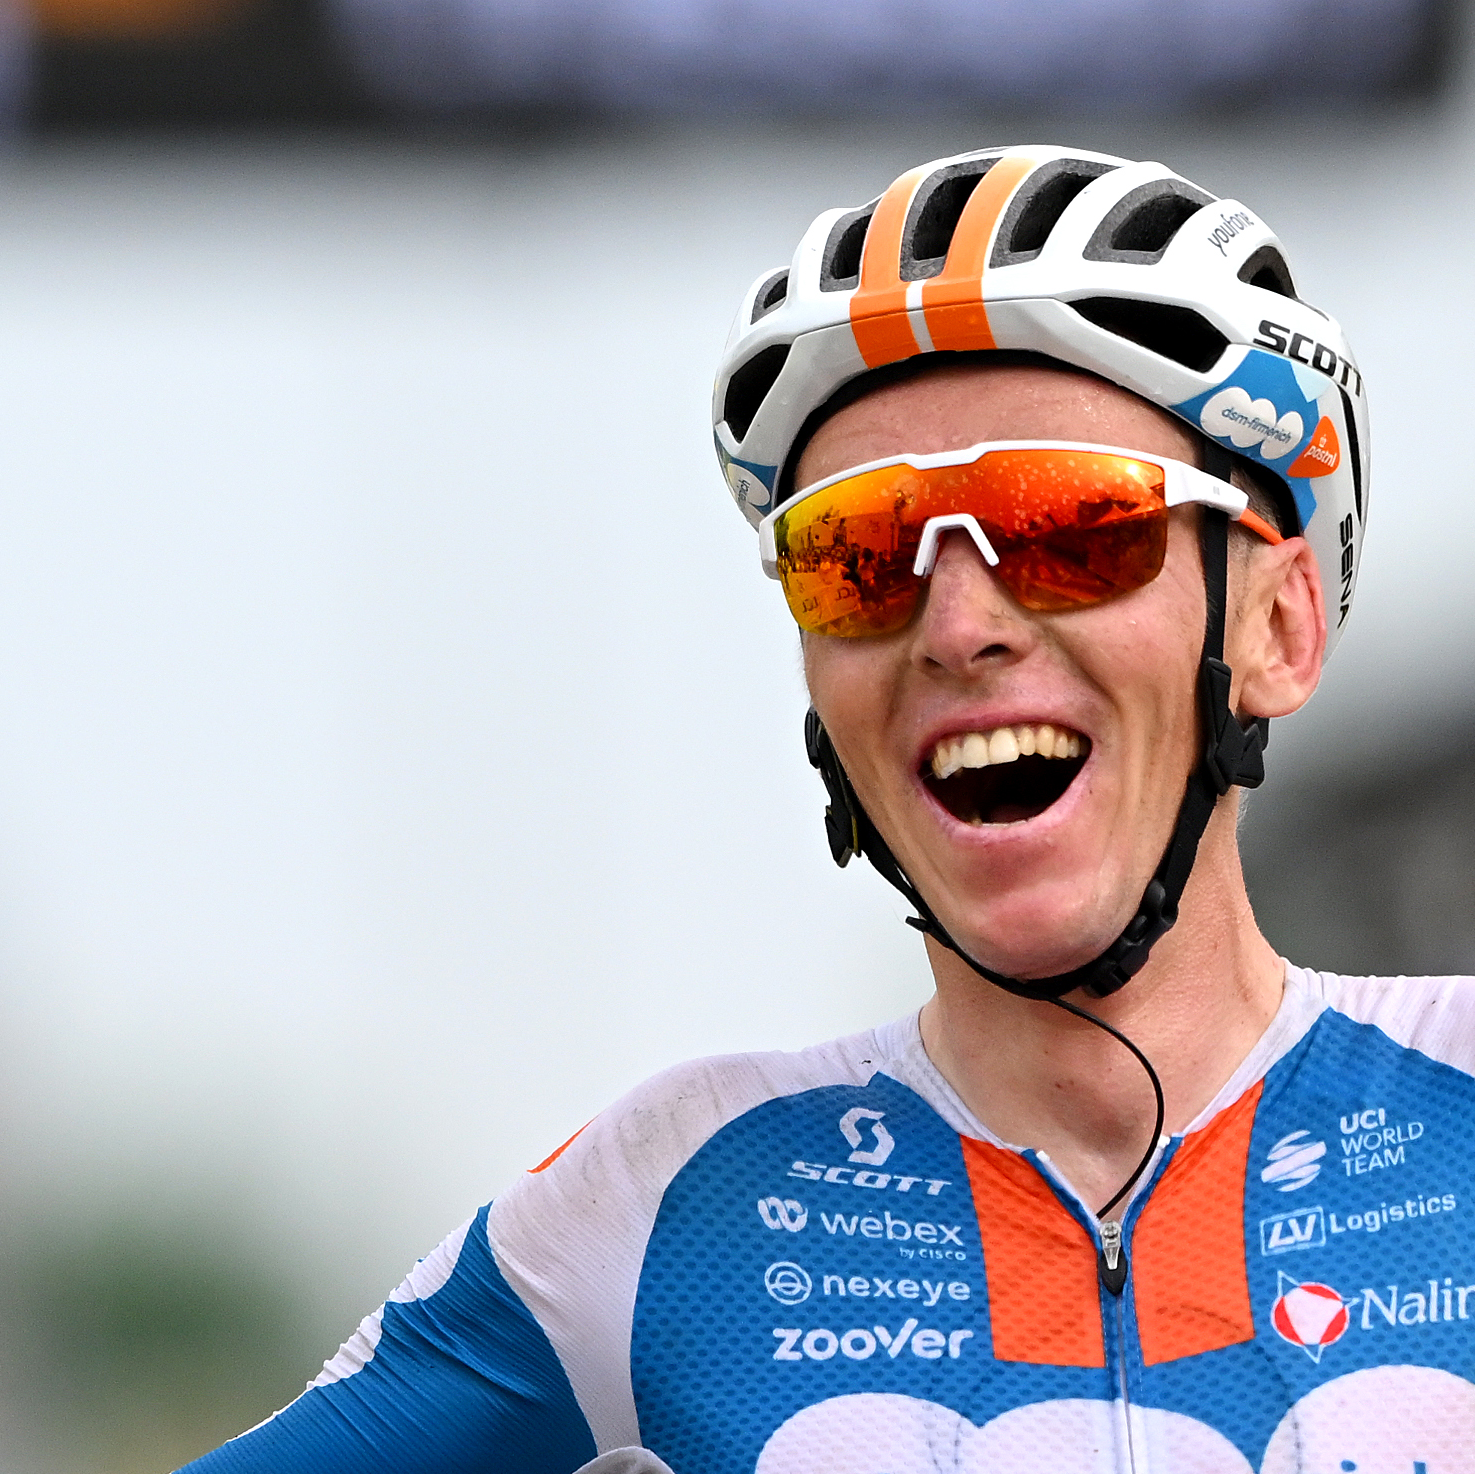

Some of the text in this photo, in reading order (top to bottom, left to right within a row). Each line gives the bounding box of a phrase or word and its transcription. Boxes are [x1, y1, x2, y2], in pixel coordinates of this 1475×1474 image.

[1207, 211, 1254, 257] youfone
[1253, 319, 1362, 398] SCOTT
[1221, 407, 1292, 444] dsm-firmenich
[1304, 444, 1338, 467] postnl
[1340, 1108, 1386, 1135] UCI
[1341, 1121, 1424, 1156] WORLD
[786, 1161, 953, 1196] SCOTT
[1341, 1146, 1406, 1176] TEAM
[820, 1211, 964, 1246] webex
[1268, 1193, 1457, 1248] LV Logistics
[899, 1247, 915, 1260] by
[823, 1273, 970, 1306] nexeye
